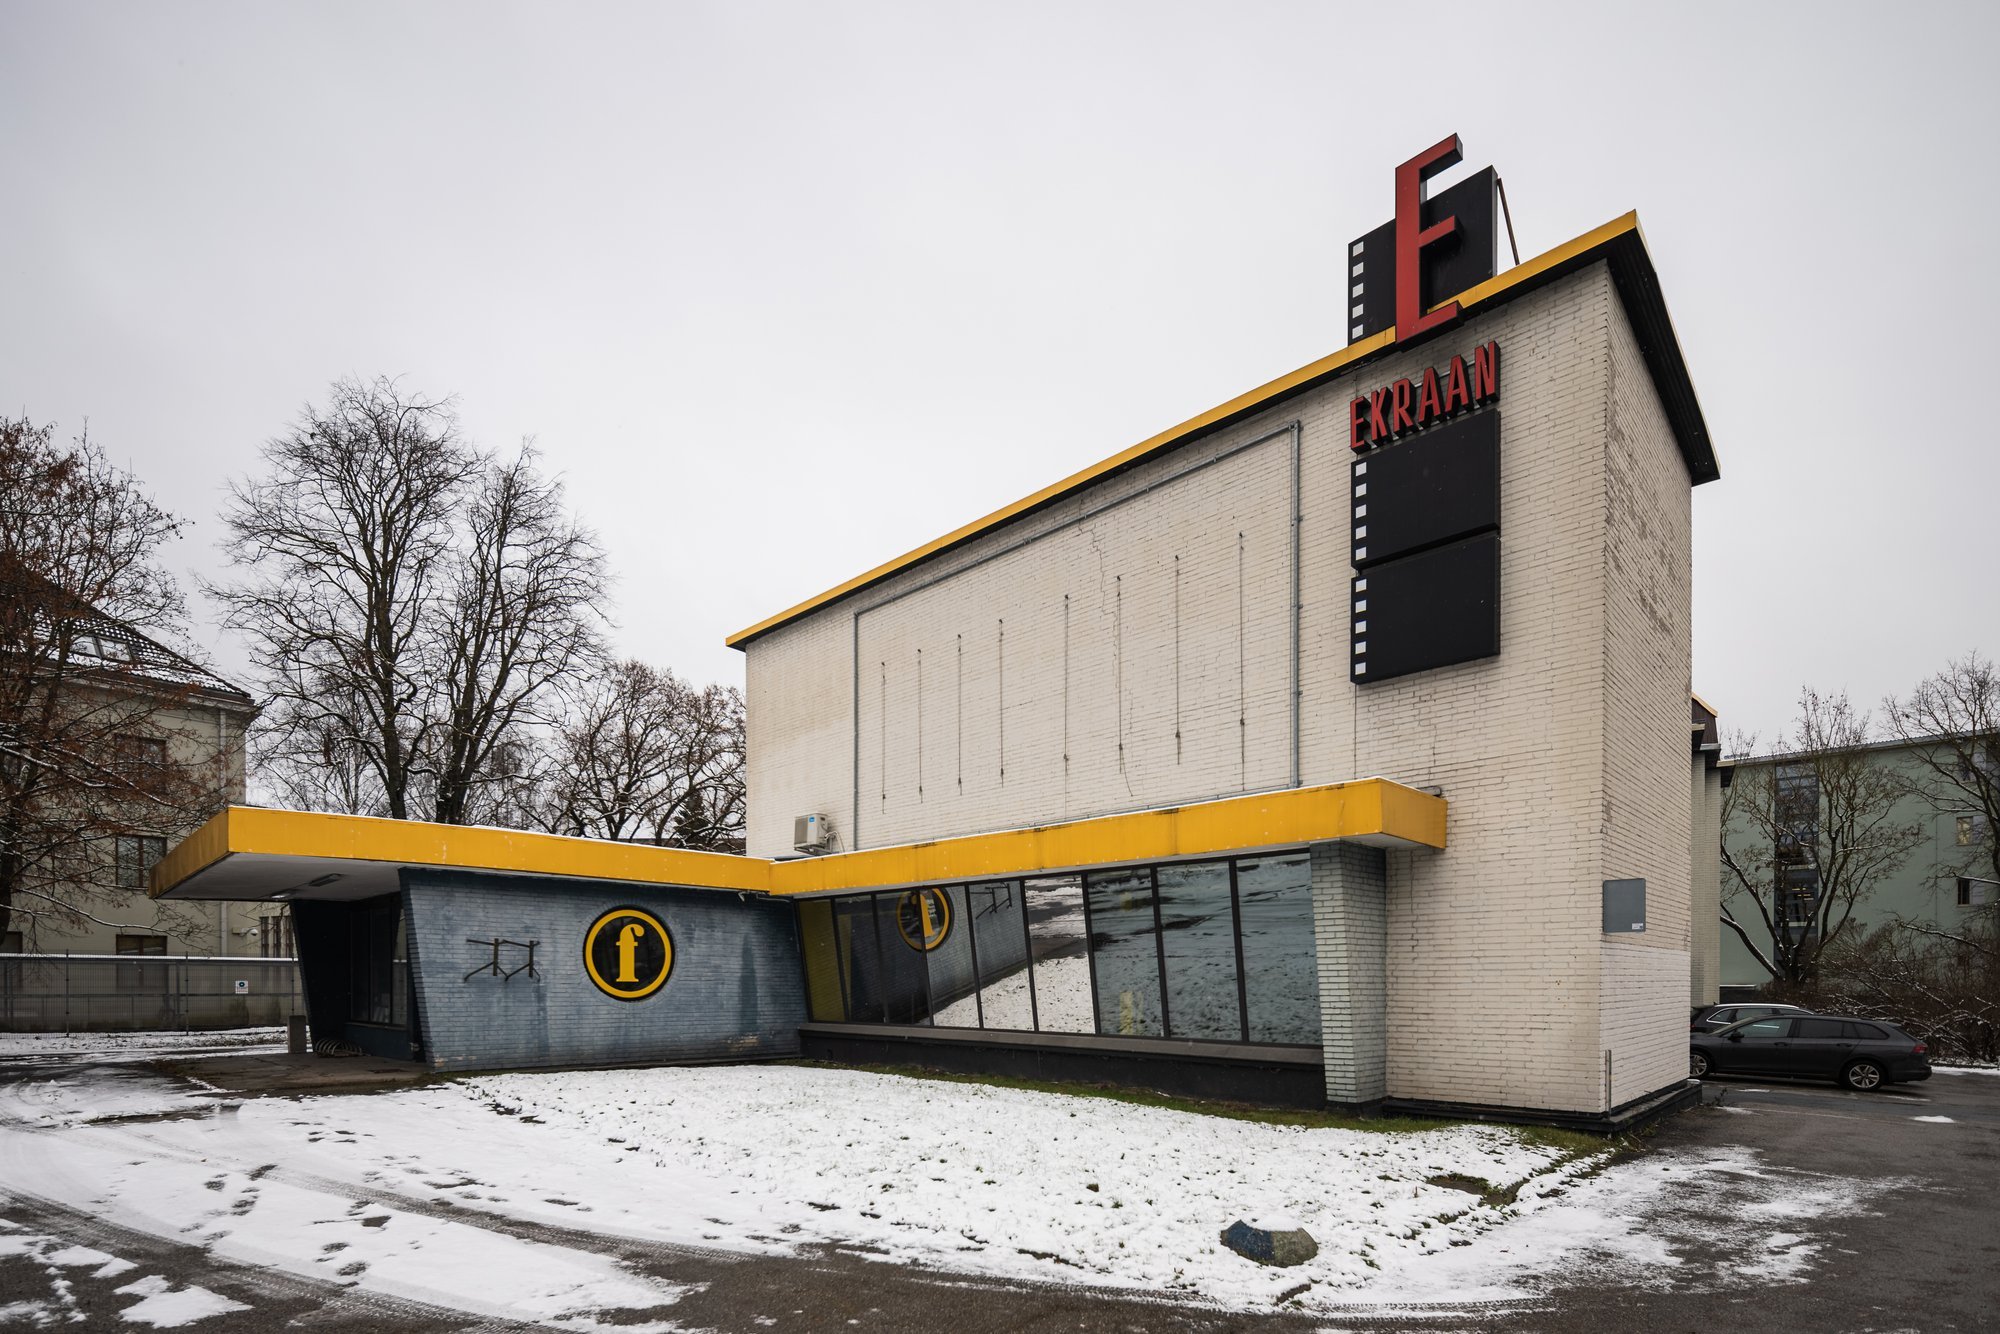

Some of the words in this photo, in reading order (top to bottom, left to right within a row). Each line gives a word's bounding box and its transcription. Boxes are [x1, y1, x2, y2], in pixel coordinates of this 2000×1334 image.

[1395, 132, 1463, 344] E
[1350, 340, 1500, 453] EKRAAN
[615, 923, 645, 982] f
